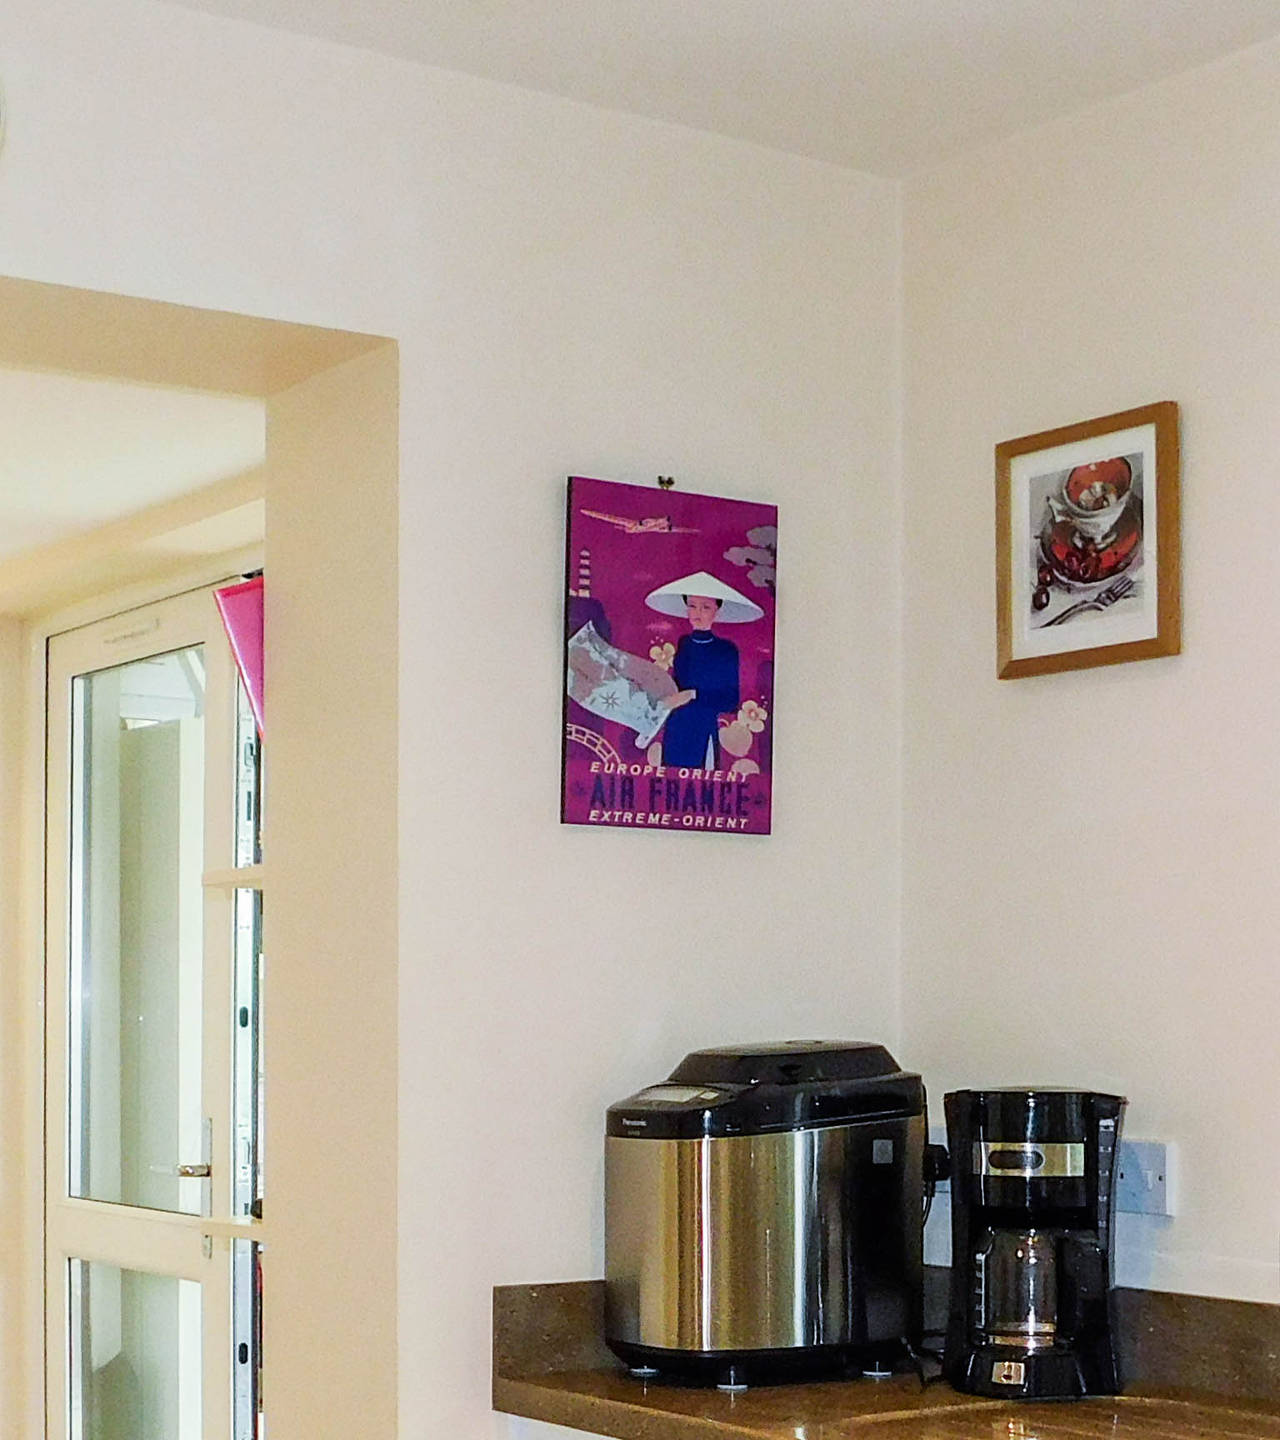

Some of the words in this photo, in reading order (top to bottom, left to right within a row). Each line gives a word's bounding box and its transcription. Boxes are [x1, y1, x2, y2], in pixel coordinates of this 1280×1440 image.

[590, 762, 667, 778] EUROPE
[678, 767, 748, 782] ORIENT
[590, 773, 635, 809] AIR
[649, 777, 751, 817] FRANCE
[588, 810, 749, 830] EXTREME-ORIENT
